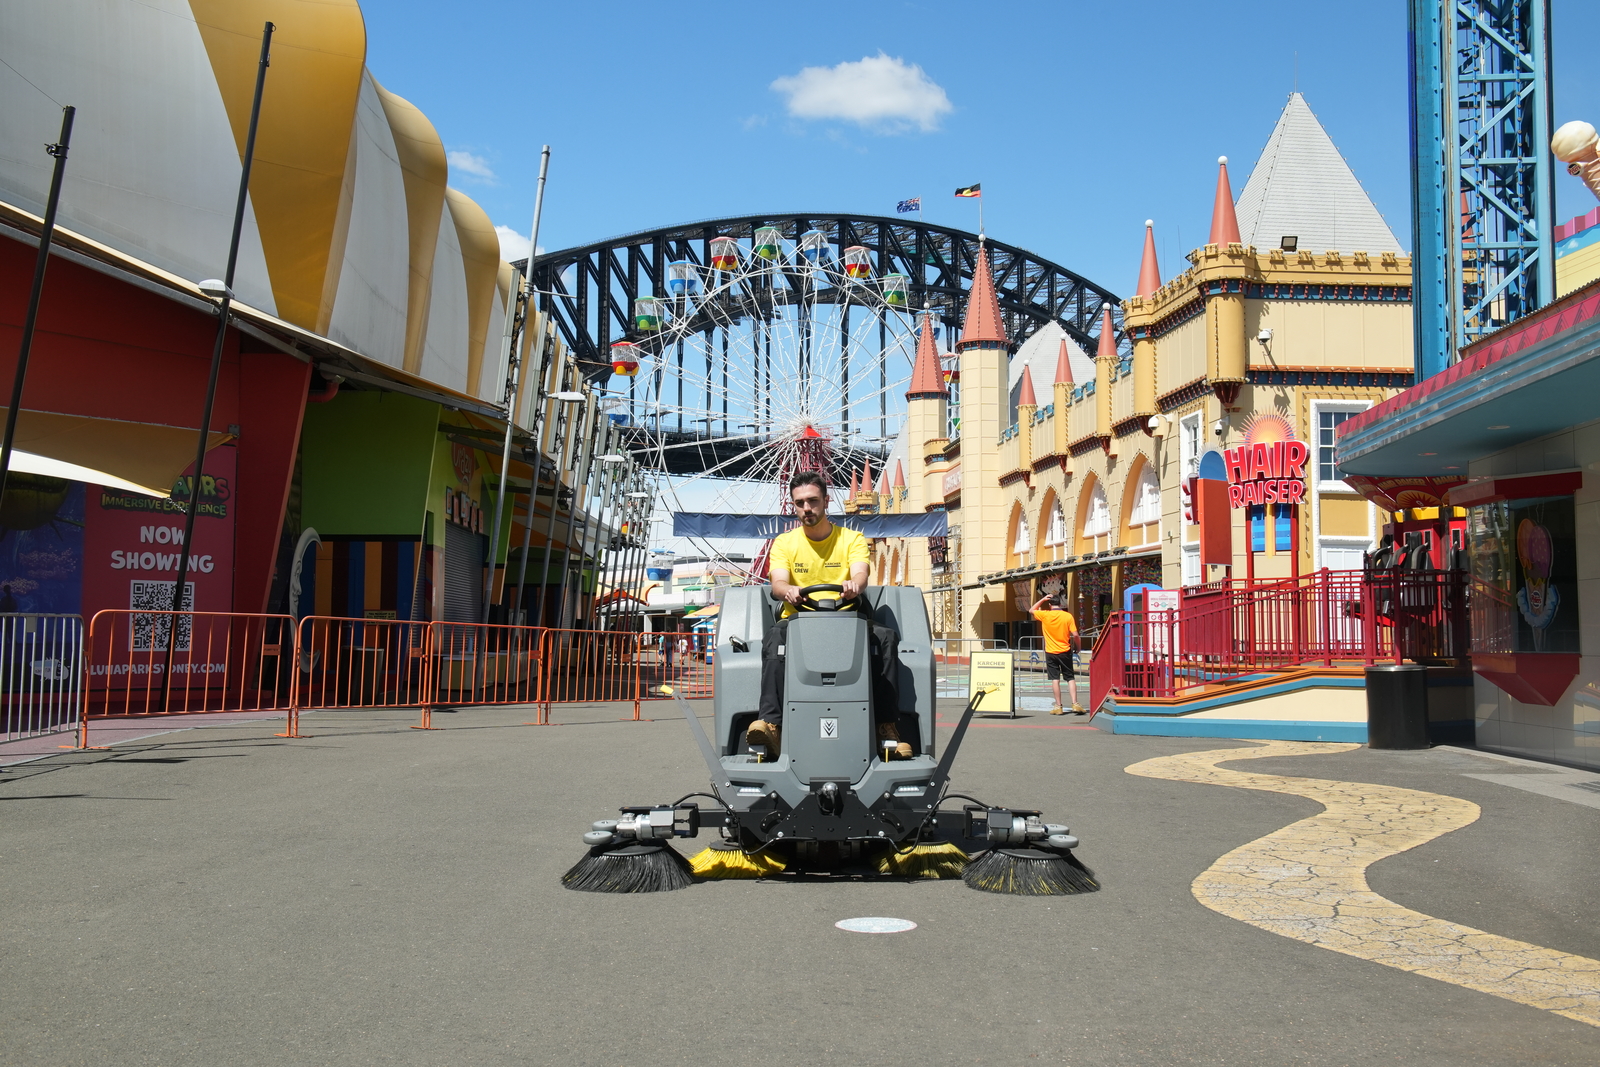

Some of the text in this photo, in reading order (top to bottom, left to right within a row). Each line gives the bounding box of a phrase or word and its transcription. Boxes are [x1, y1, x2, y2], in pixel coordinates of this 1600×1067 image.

[1223, 441, 1310, 484] HAIR
[101, 493, 227, 515] IMMERSIVE EXPEIENCE
[1227, 480, 1305, 508] RAISER
[140, 526, 186, 545] NOW
[110, 550, 214, 573] SHOWING
